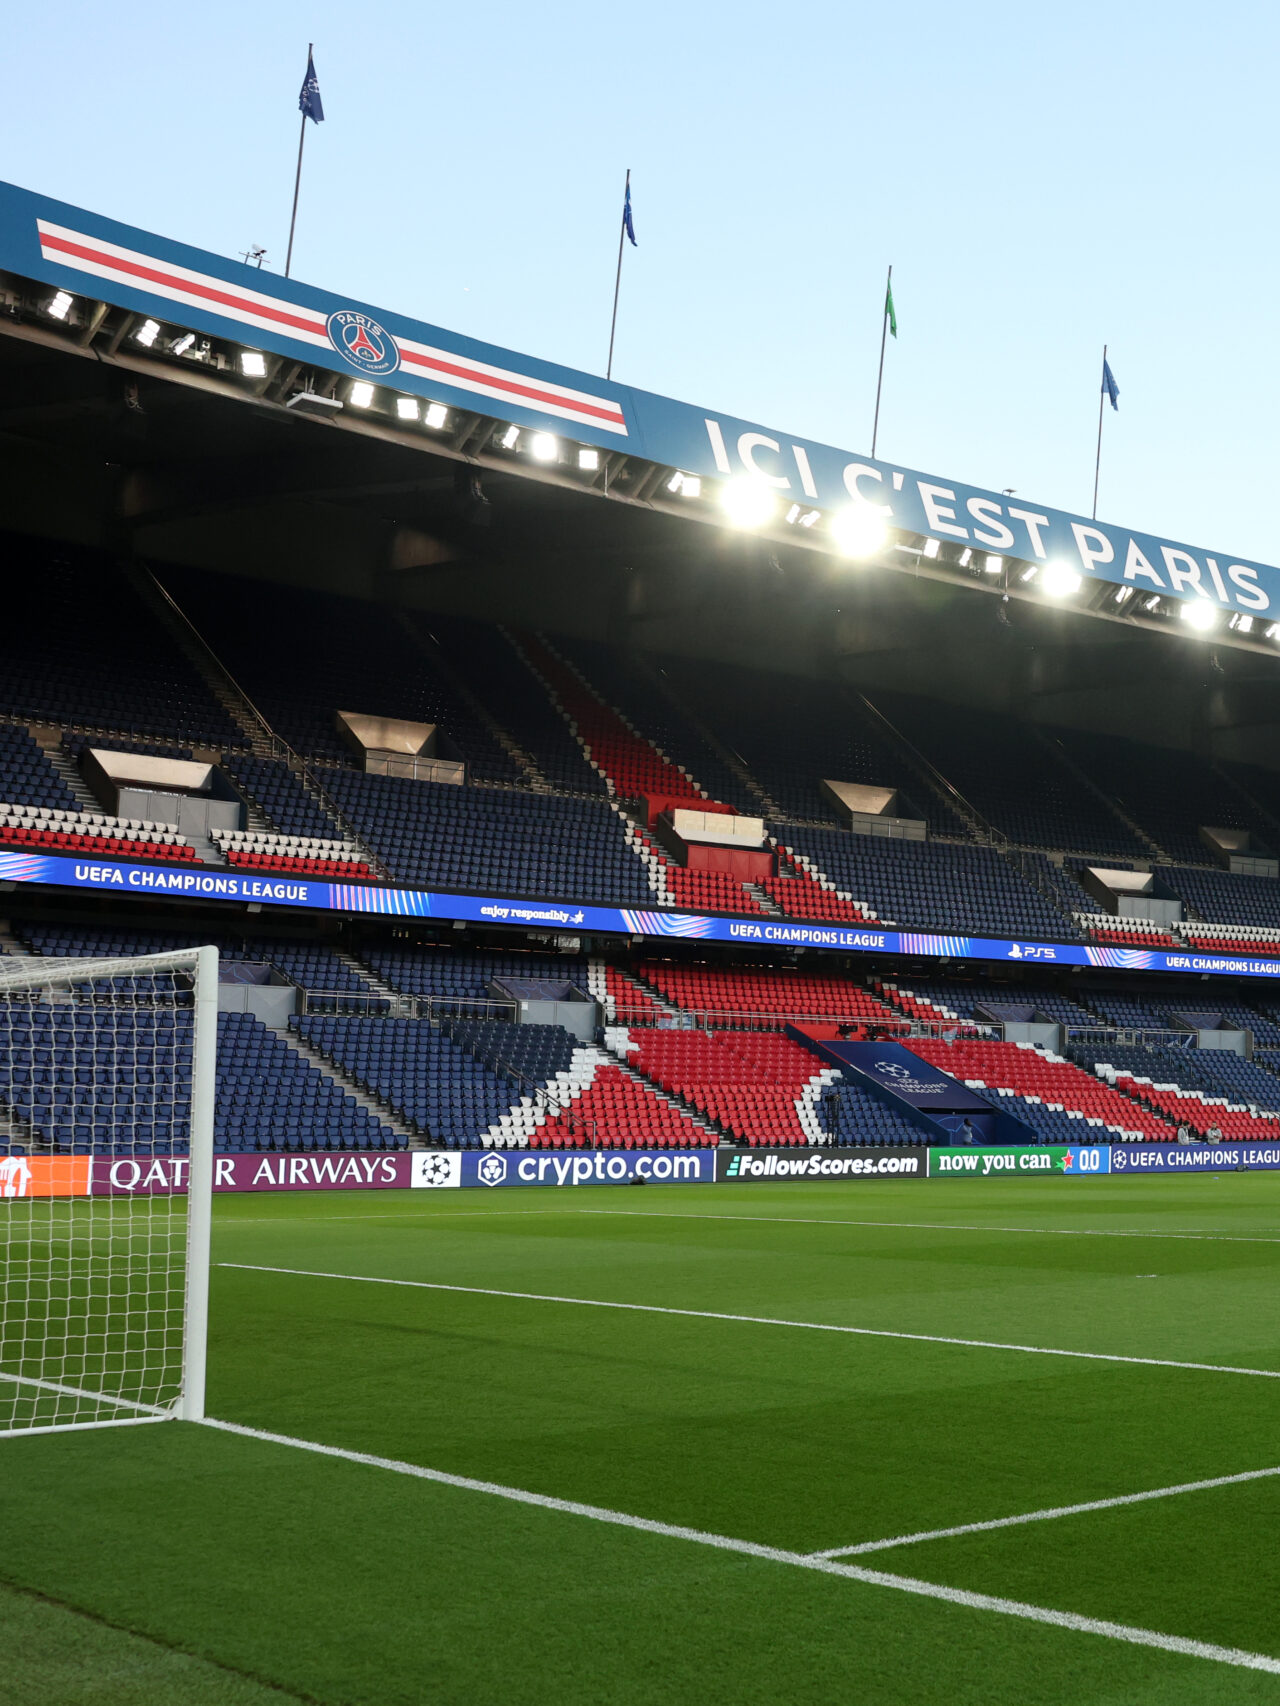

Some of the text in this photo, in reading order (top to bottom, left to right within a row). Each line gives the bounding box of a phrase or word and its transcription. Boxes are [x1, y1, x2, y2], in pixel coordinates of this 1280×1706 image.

[336, 313, 382, 336] PARIS
[704, 418, 1271, 611] ICI C'EST PARIS
[75, 865, 308, 901] UEFA CHAMPIONS LEAGUE
[480, 905, 569, 923] enjoy responsibly
[729, 923, 885, 948] UEFA CHAMPIONS LEAGUE
[1024, 946, 1056, 958] PS5
[1166, 956, 1191, 969] UEFA
[1192, 958, 1248, 972] CHAMPIONS
[518, 1152, 700, 1185] crypto.com
[738, 1155, 918, 1176] FollowScores.com
[939, 1154, 1051, 1174] now you can
[1079, 1149, 1099, 1171] 0.0
[1130, 1152, 1165, 1167] UEFA
[1167, 1149, 1240, 1166] CHAMPIONS
[110, 1157, 397, 1190] QATR AIRWAYS
